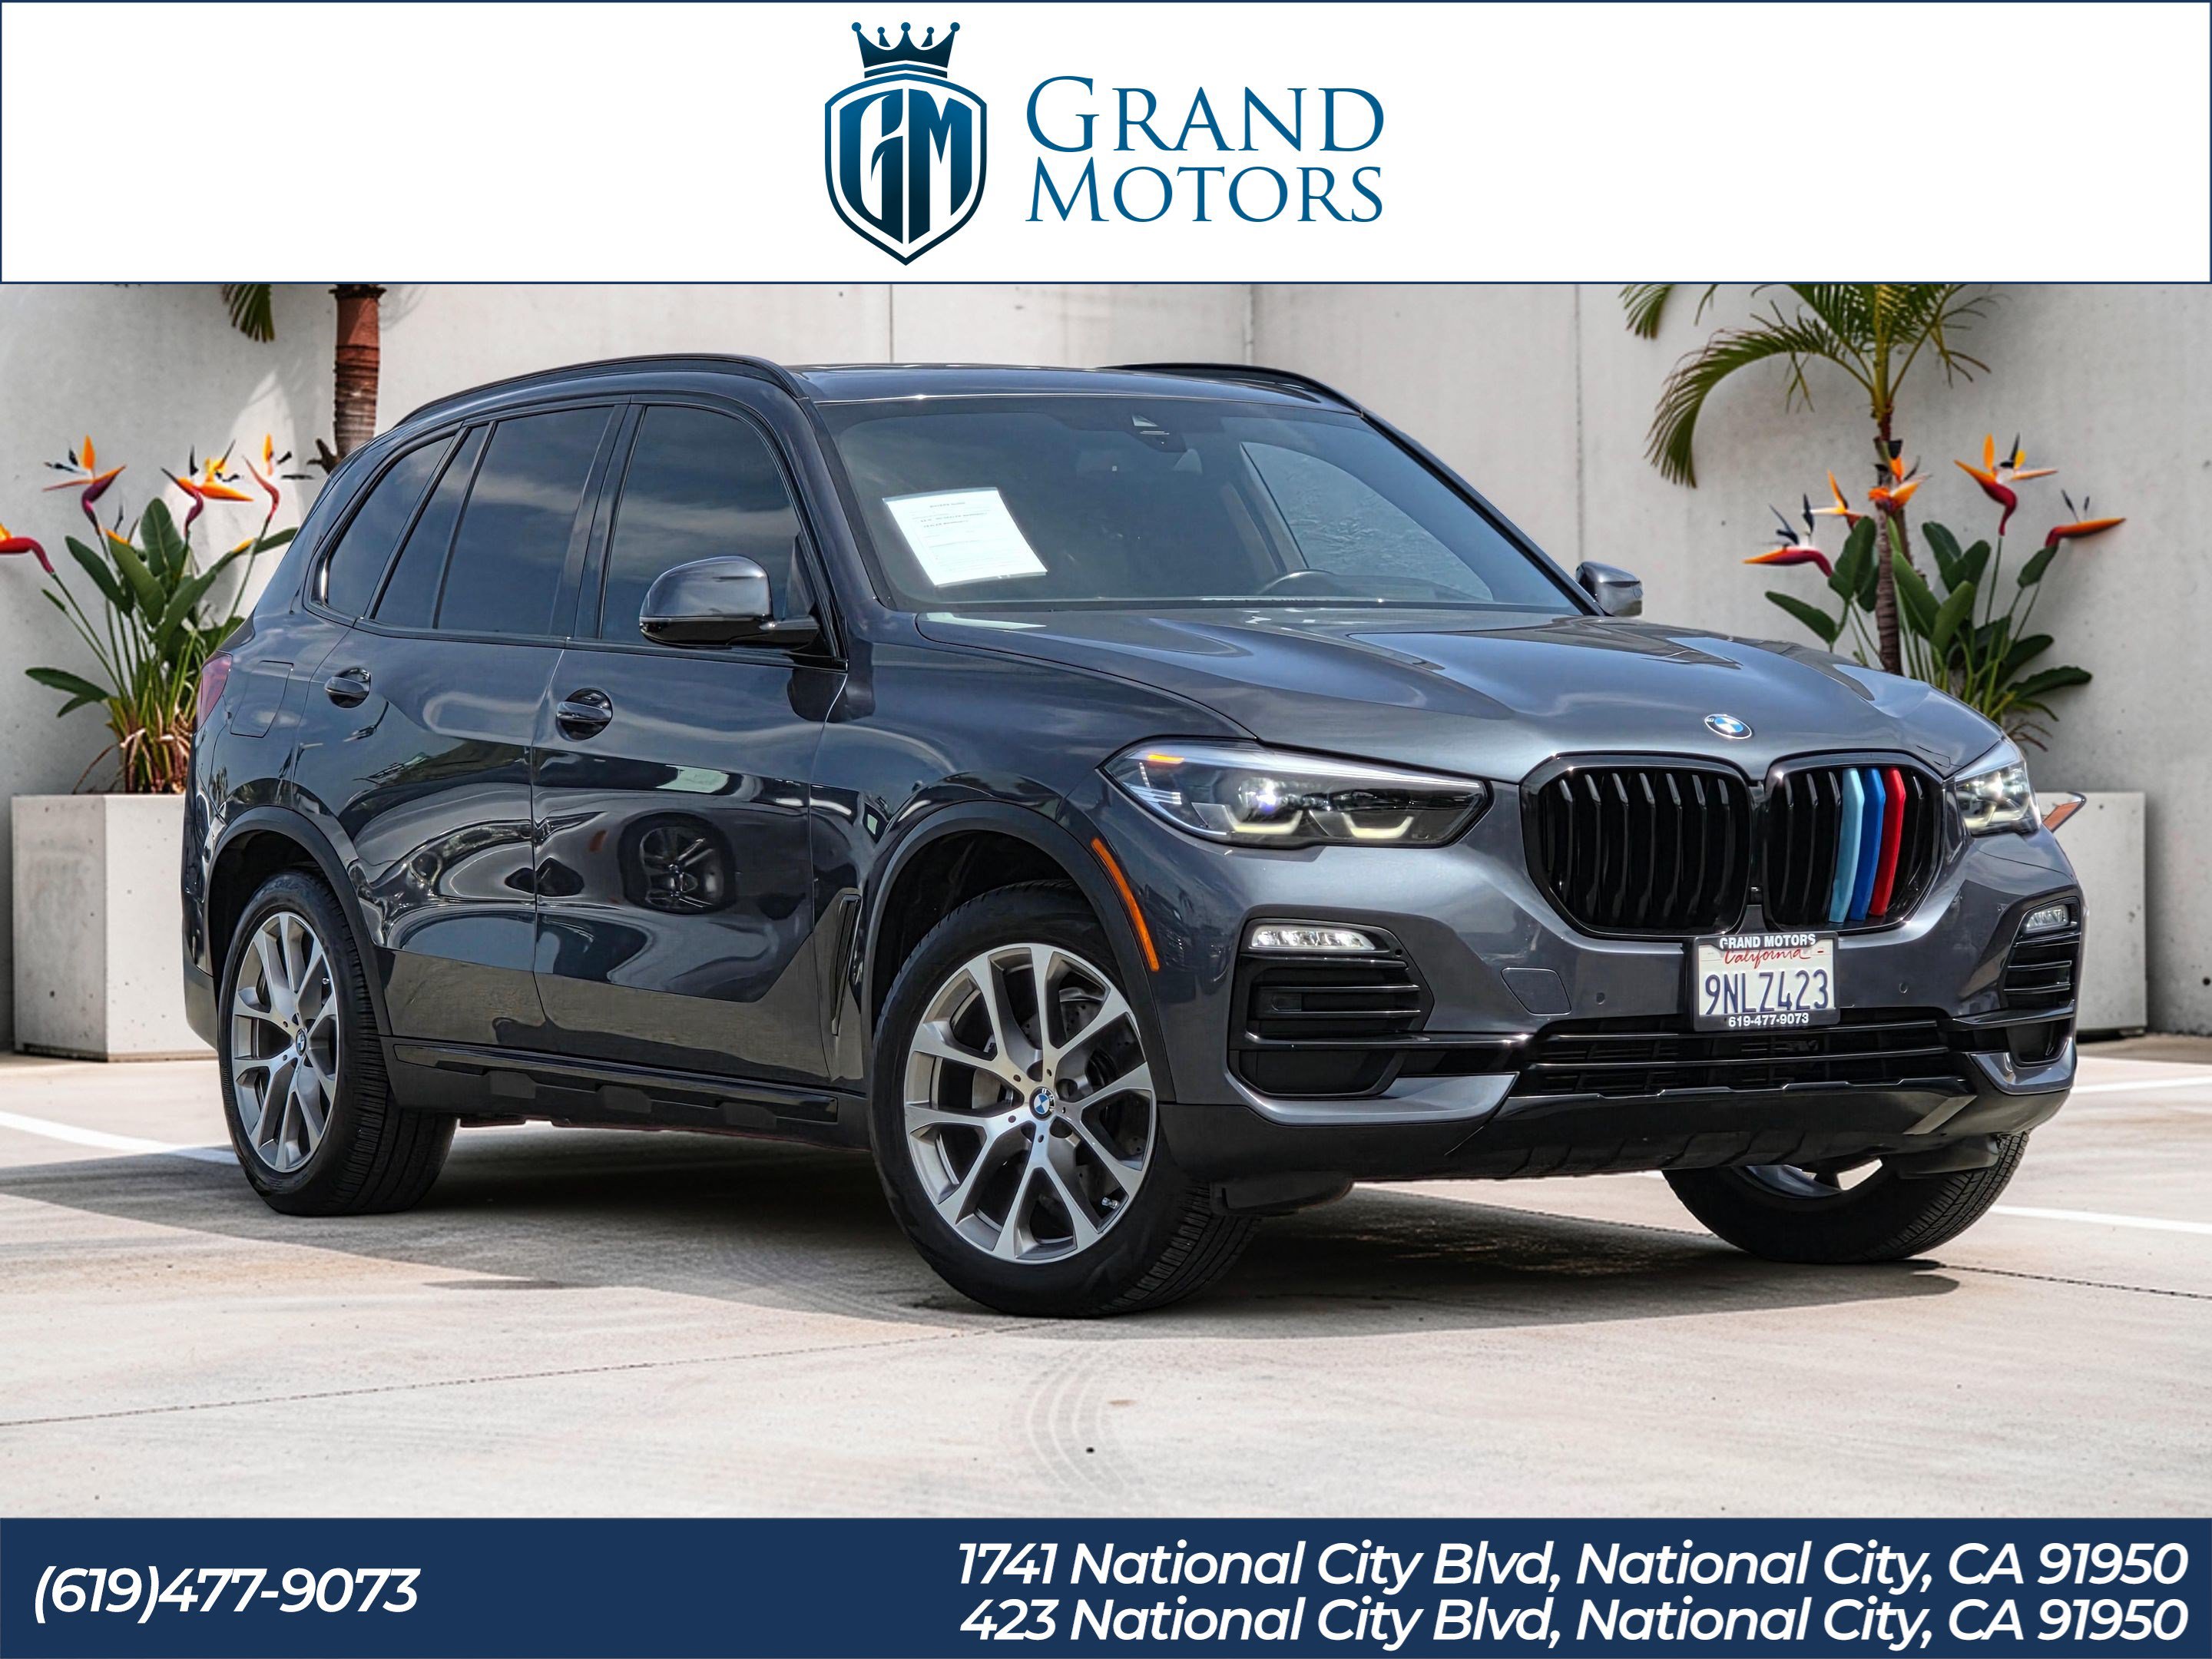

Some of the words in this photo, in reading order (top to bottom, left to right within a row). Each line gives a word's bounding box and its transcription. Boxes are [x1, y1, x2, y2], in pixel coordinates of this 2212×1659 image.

[1719, 936, 1761, 949] GRAND
[1764, 933, 1816, 948] MOTORS
[1724, 949, 1810, 969] California
[1705, 969, 1829, 1015] 9NLZ423
[1728, 1012, 1810, 1028] 619-477-9073
